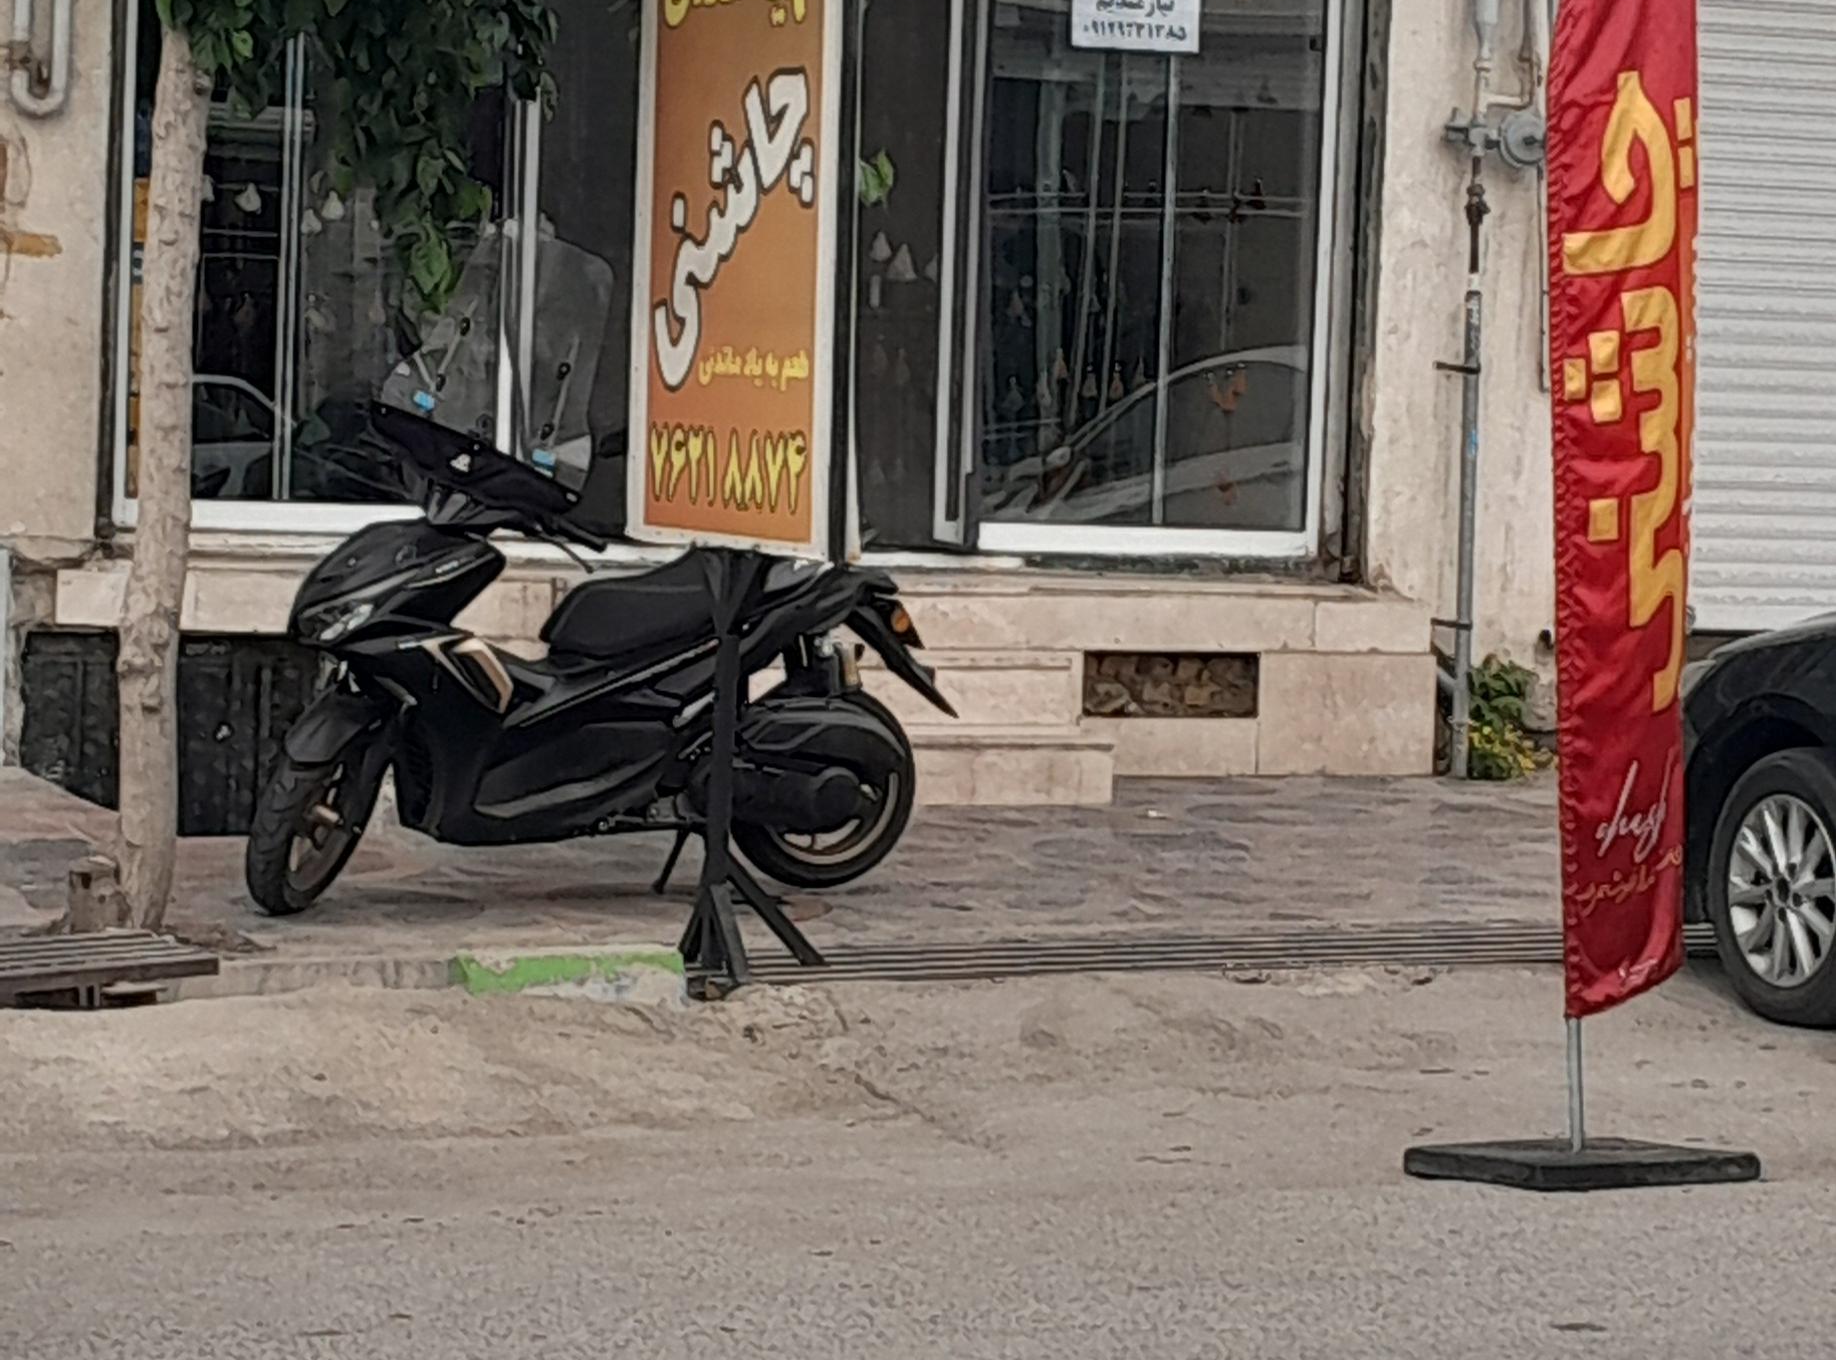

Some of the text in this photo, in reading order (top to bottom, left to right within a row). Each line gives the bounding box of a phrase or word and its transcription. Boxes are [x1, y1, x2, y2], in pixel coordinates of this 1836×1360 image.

[653, 67, 814, 392] چاشنی
[650, 421, 807, 516] ۷۶۲۱ ۸۸۷۴
[781, 349, 809, 392] طعم
[1563, 71, 1694, 712] چاشنی
